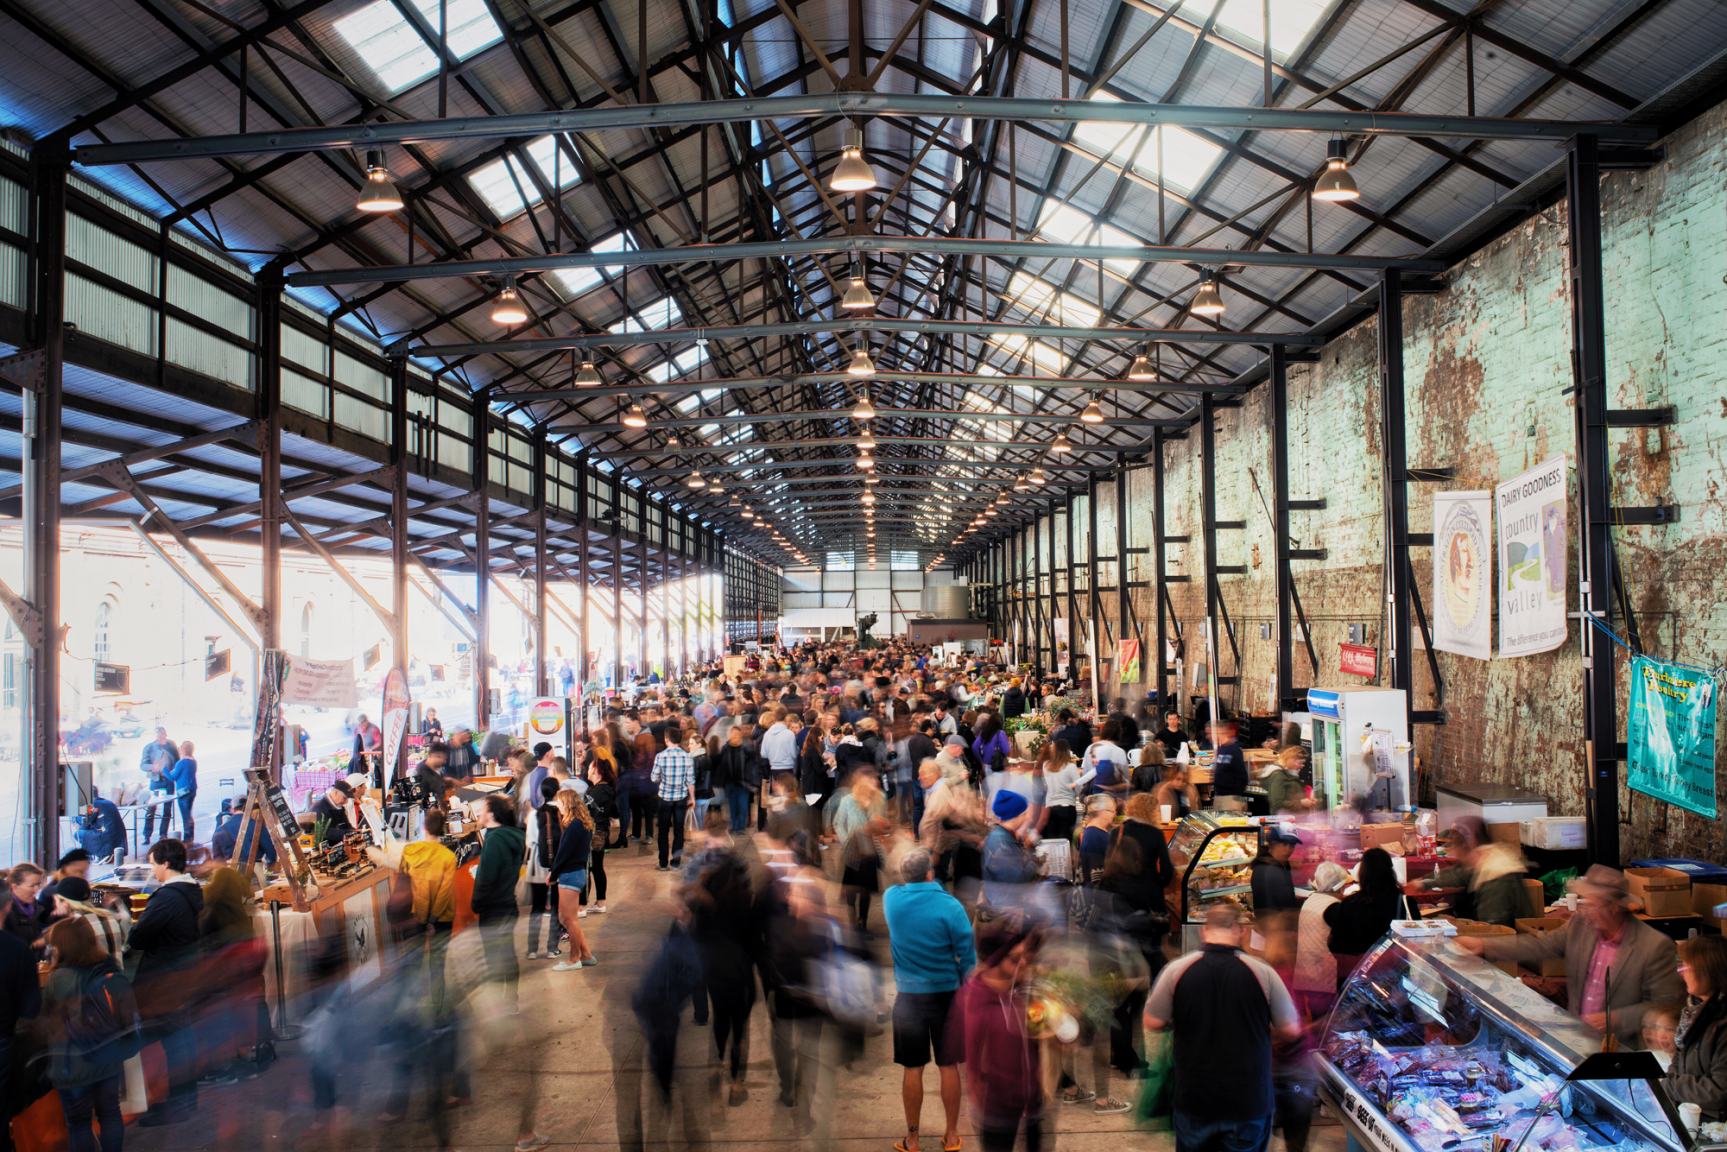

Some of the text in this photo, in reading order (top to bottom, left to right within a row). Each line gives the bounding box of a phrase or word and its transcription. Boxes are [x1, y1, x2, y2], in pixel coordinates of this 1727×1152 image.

[1501, 468, 1562, 508] DAIRY GOODNESS
[1505, 512, 1538, 540] country
[1507, 589, 1542, 615] valley
[1506, 636, 1516, 647] The
[1517, 633, 1538, 646] difference
[1539, 631, 1549, 643] you
[1550, 628, 1558, 639] can
[1647, 680, 1689, 704] Poultry
[386, 709, 403, 766] COFFEE
[1671, 773, 1691, 792] Turkey
[1692, 782, 1714, 798] Breast
